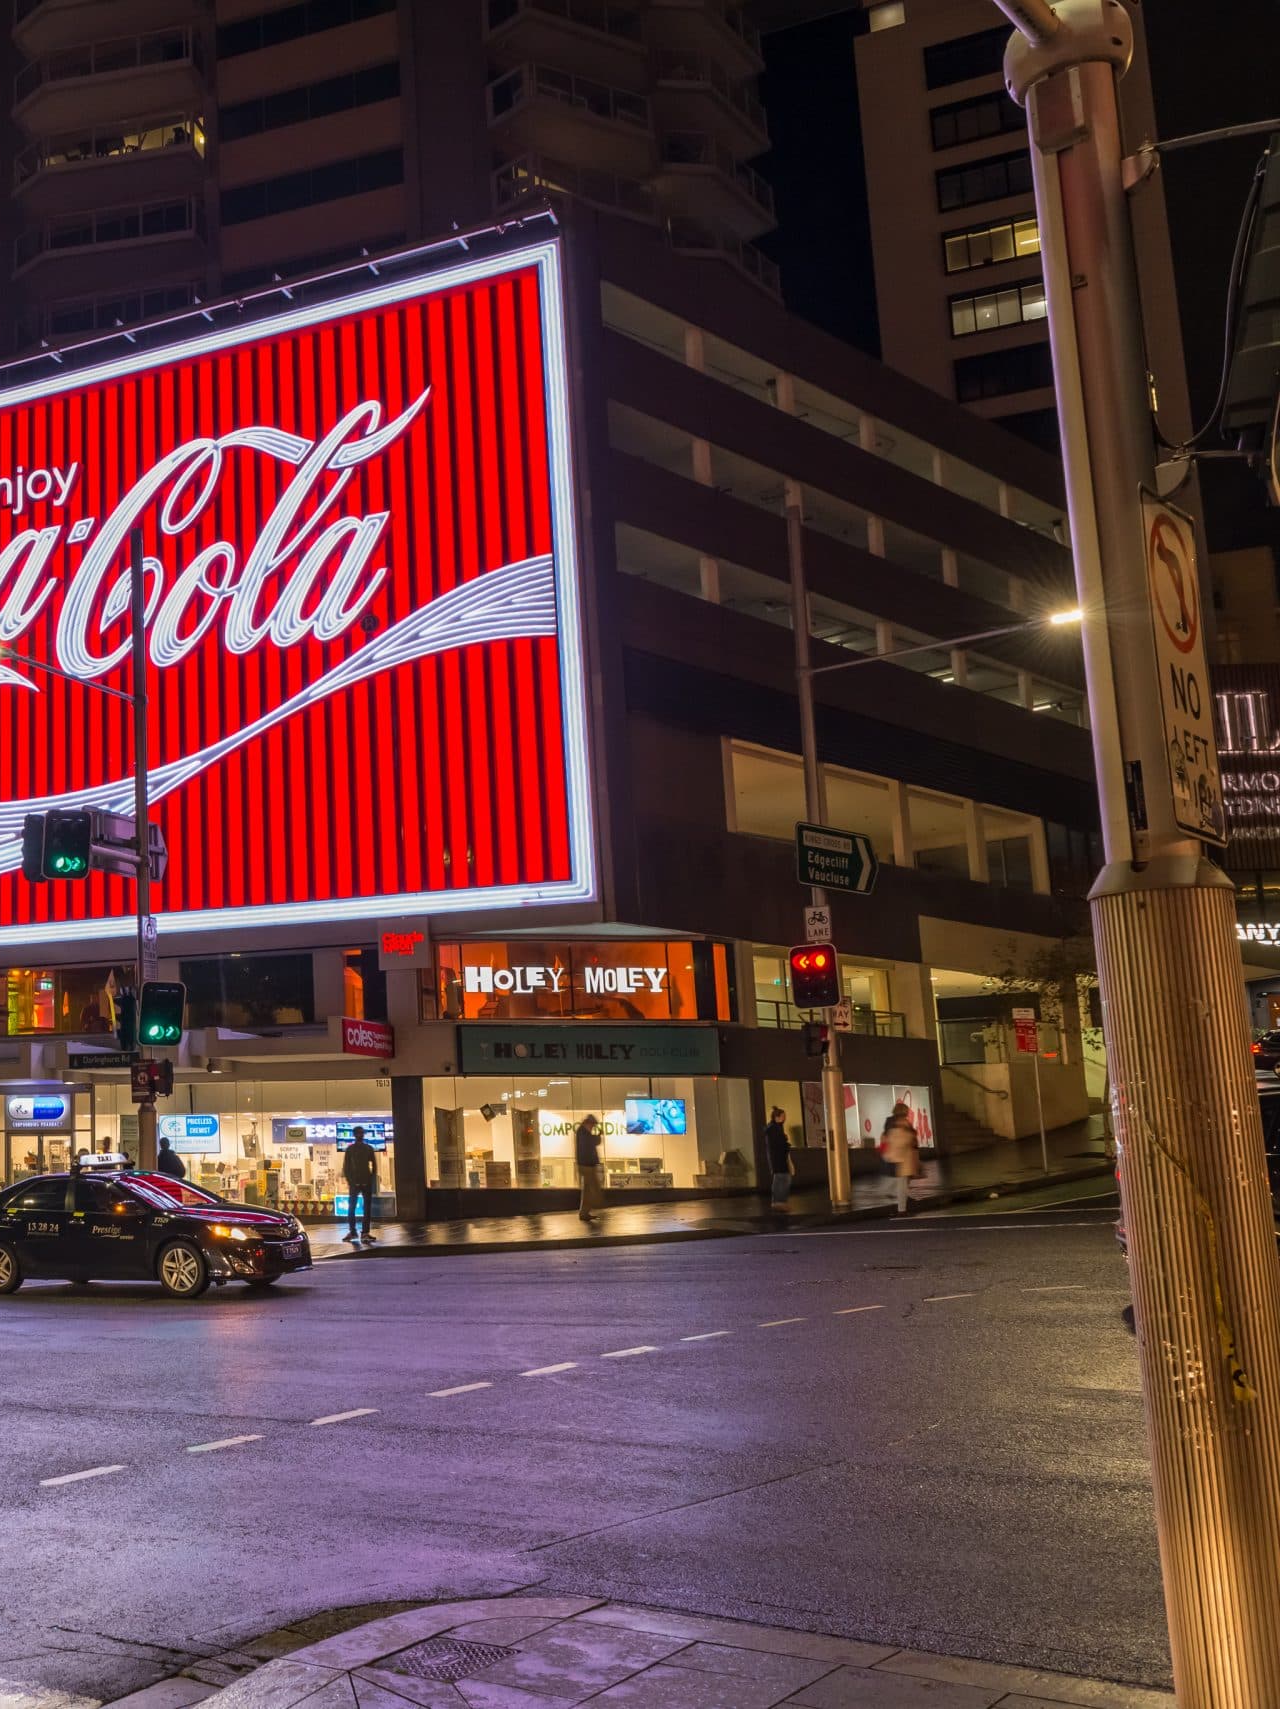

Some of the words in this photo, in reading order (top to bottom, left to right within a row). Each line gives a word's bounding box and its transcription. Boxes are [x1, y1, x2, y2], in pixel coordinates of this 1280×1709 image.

[1170, 663, 1200, 720] NO
[808, 851, 848, 870] Edgecliff
[808, 866, 850, 886] Vaucluse
[808, 928, 829, 938] LANE
[464, 966, 564, 994] HOLEY
[584, 967, 668, 994] MOLEY
[347, 1024, 374, 1048] coles
[28, 1222, 36, 1232] 13
[38, 1223, 48, 1232] 28
[49, 1224, 59, 1232] 24
[92, 1224, 122, 1236] Prestige
